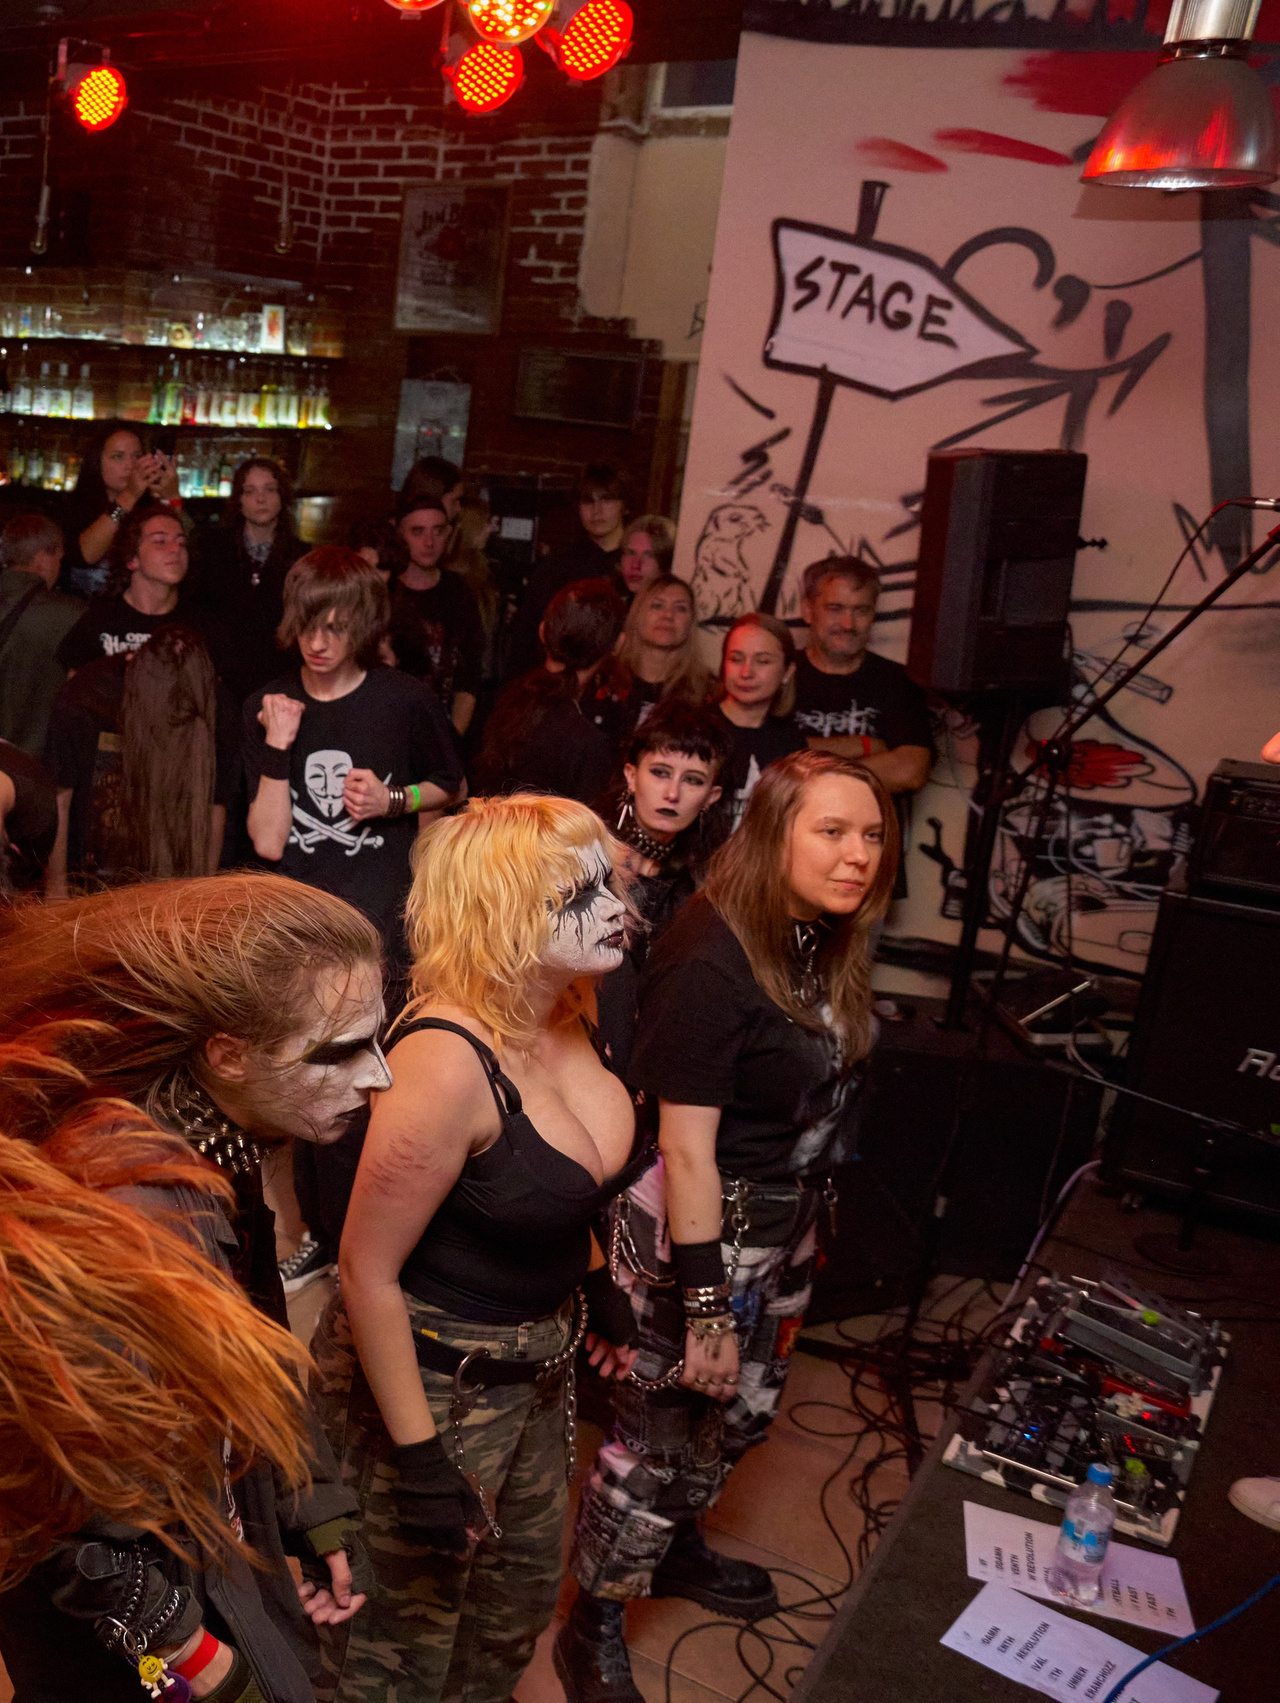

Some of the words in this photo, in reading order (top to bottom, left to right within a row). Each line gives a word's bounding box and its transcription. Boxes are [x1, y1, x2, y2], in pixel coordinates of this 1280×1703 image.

[792, 256, 959, 350] STAGE
[1025, 1532, 1037, 1574] REVOLUTION
[1017, 1621, 1051, 1660] REVOLUTION
[1067, 1667, 1089, 1690] UMBER
